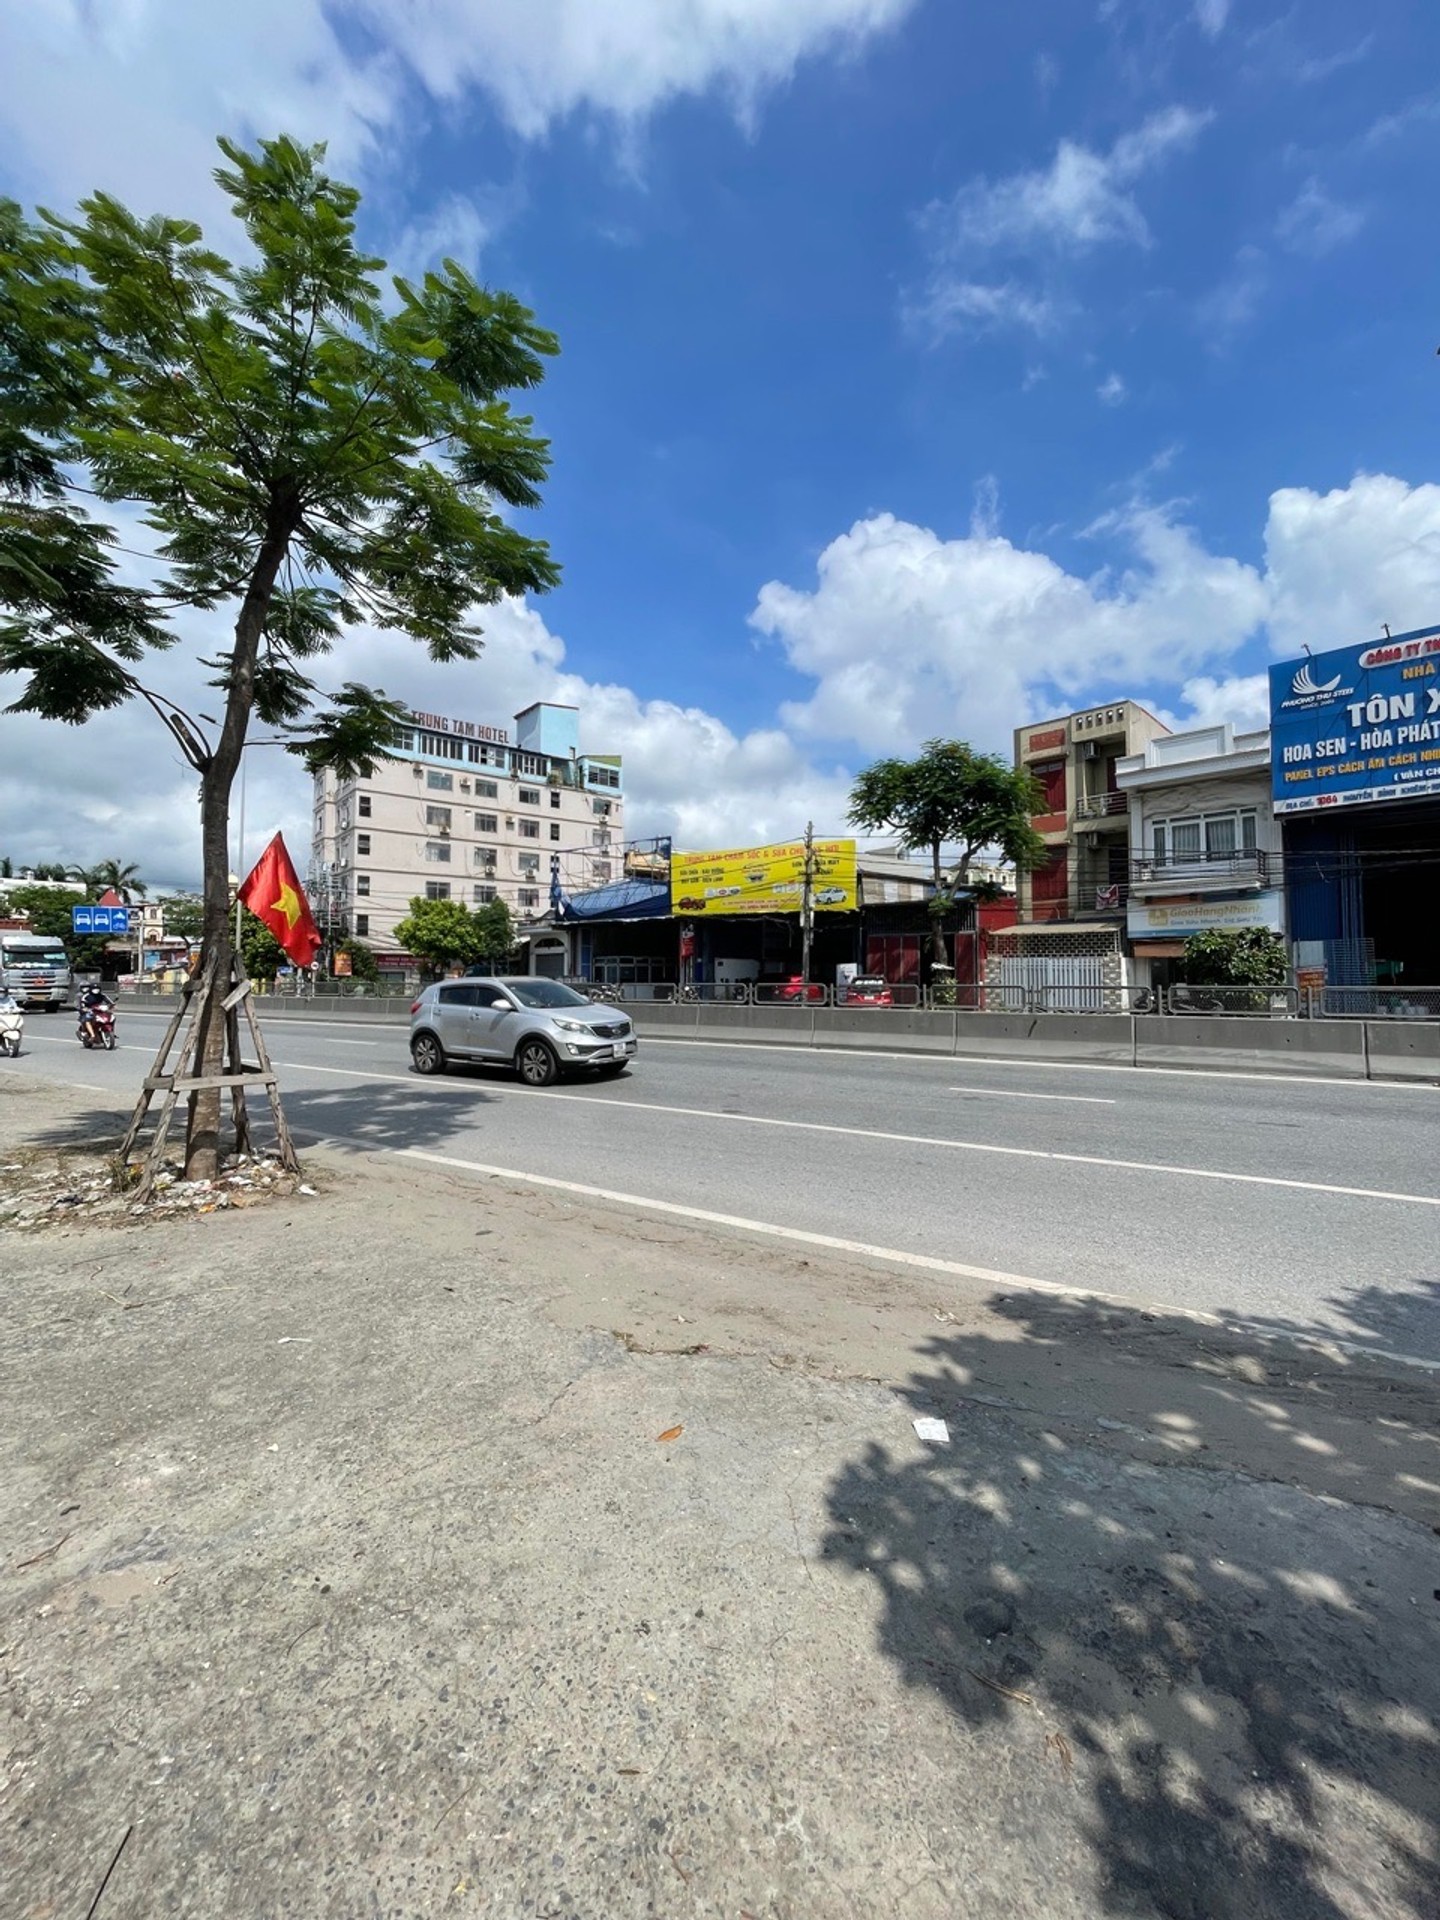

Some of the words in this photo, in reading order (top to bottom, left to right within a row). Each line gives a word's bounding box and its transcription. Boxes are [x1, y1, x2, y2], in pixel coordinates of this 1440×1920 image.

[1366, 648, 1401, 666] CÔNG
[1405, 642, 1421, 657] TY
[1402, 660, 1435, 680] NHÀ
[1316, 692, 1332, 701] THU
[1347, 692, 1415, 727] TÔN
[1427, 688, 1440, 714] X
[411, 710, 448, 731] TRUNG
[478, 725, 509, 743] HOTEL
[1283, 743, 1312, 763] HOA
[1315, 737, 1347, 757] SEN
[1360, 727, 1393, 750] HÒA
[1398, 719, 1440, 744] PHÁT
[1285, 771, 1313, 782] PANEL
[1317, 765, 1335, 777] EPS
[1338, 760, 1365, 774] CÁCH
[1388, 752, 1417, 767] CÁCH
